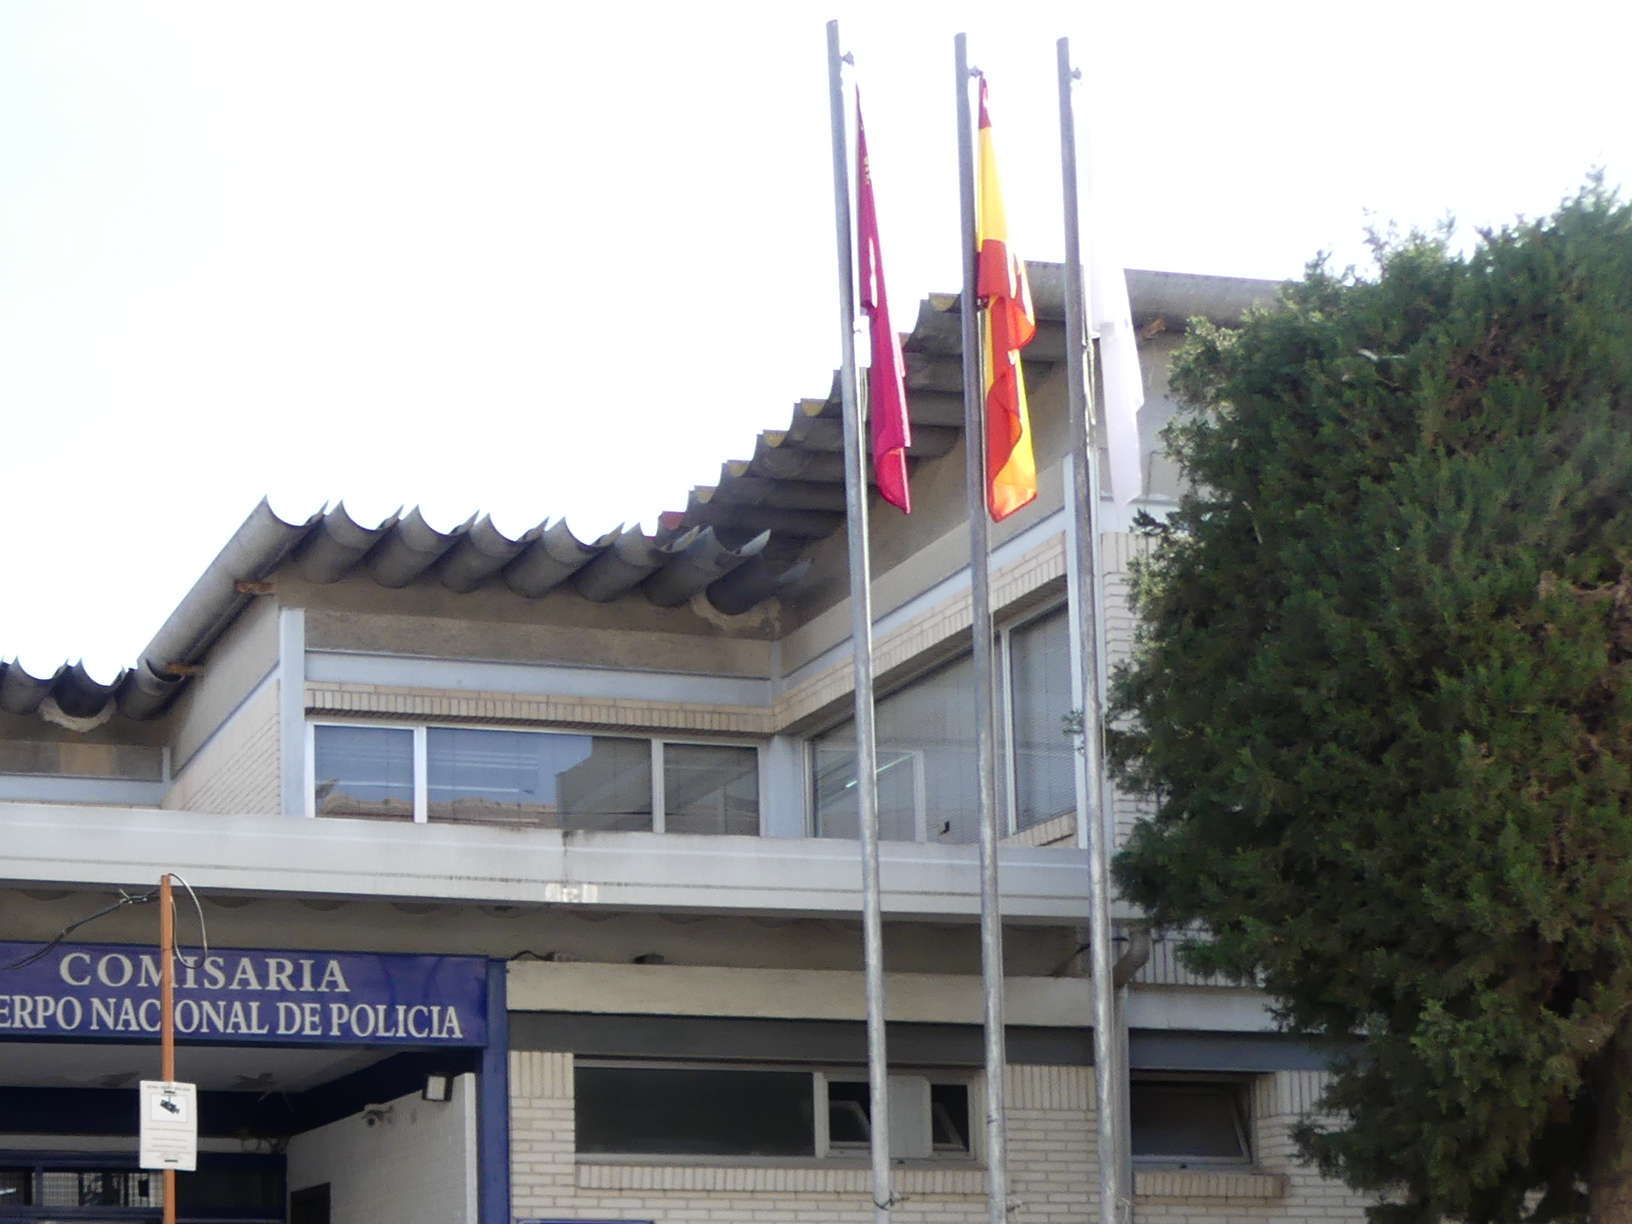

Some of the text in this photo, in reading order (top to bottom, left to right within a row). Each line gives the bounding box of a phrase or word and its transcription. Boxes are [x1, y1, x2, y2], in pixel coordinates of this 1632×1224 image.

[59, 951, 351, 992] COMISARIA
[89, 997, 269, 1035] NACONAL
[276, 1002, 323, 1036] DE
[329, 1003, 463, 1038] POLICIA
